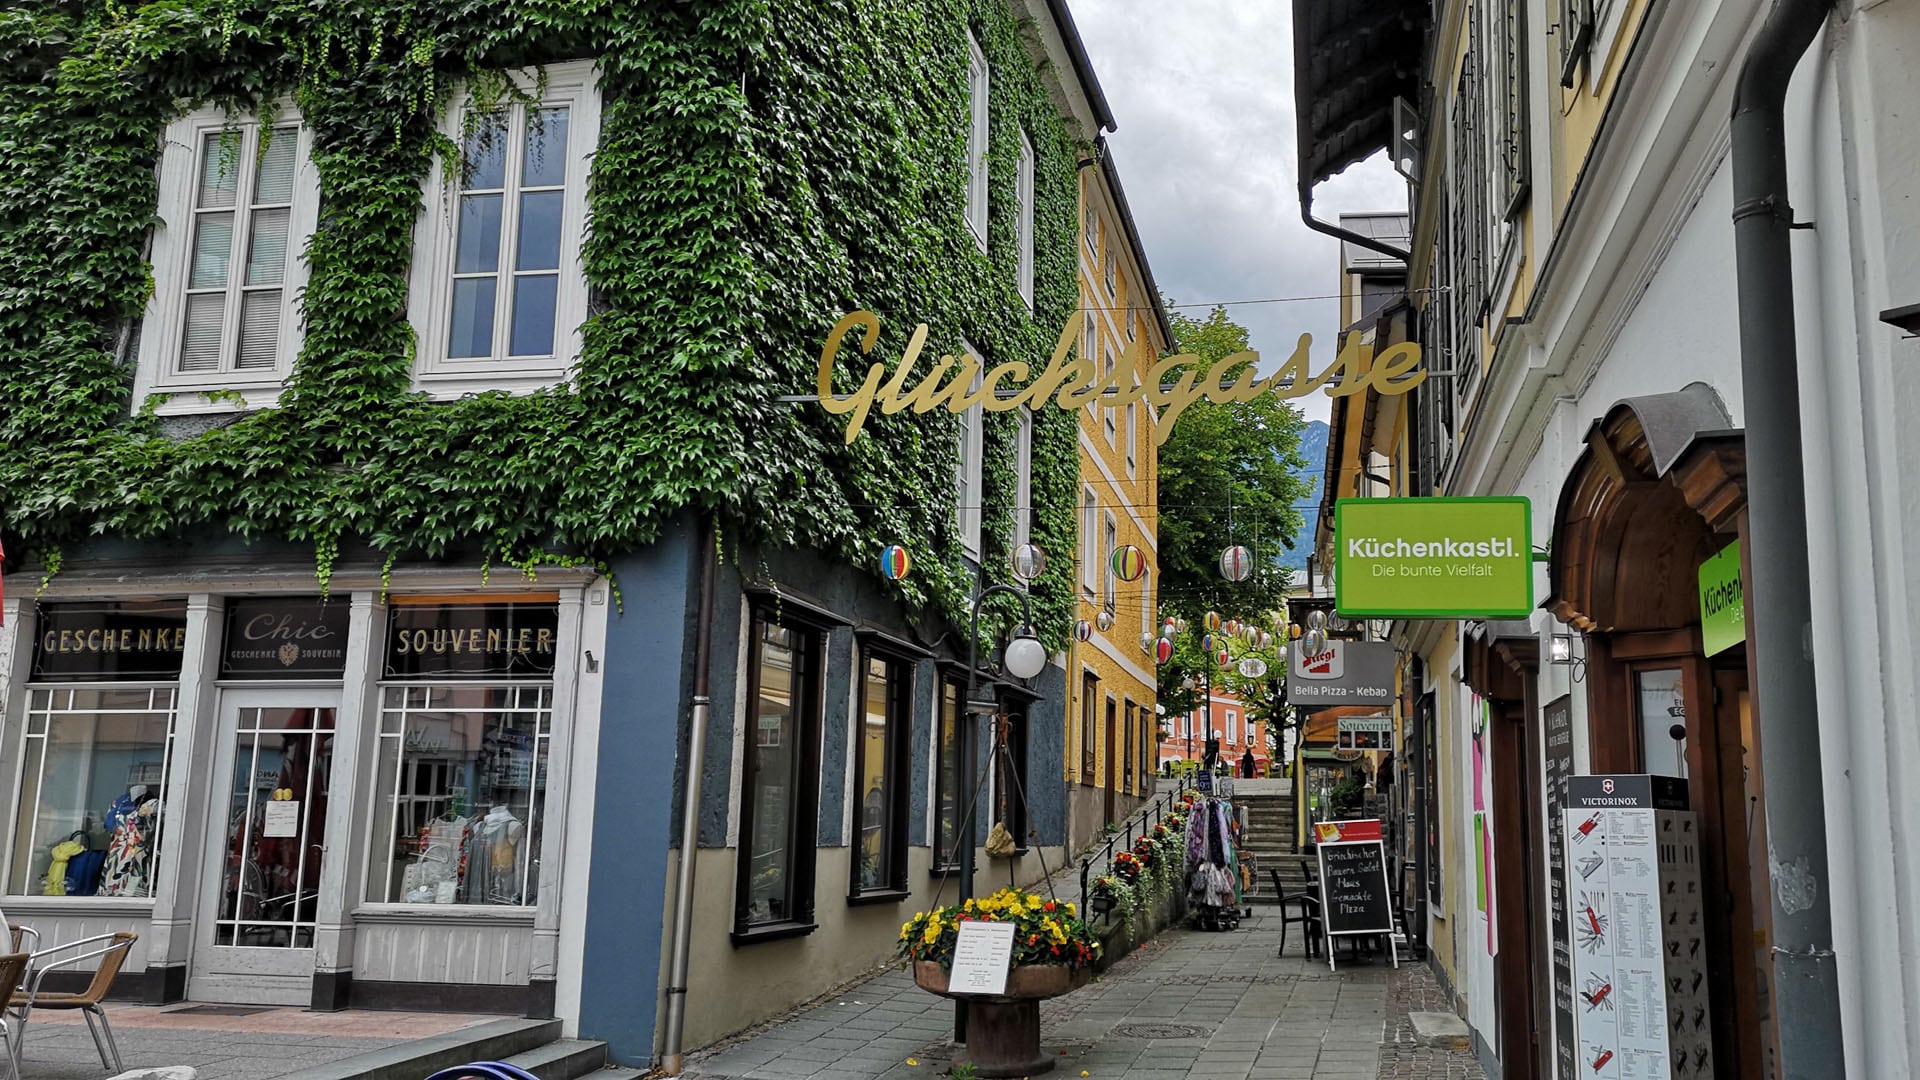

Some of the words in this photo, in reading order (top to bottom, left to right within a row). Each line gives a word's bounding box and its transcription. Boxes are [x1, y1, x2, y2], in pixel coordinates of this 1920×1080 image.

[818, 310, 1427, 446] Glücksgasse
[1349, 537, 1520, 558] Küchenkastl.
[1372, 564, 1396, 577] Die
[1400, 564, 1442, 577] bunte
[1446, 563, 1493, 577] Vielfalt
[244, 613, 335, 640] Chic
[44, 627, 187, 654] GESCHENKE
[397, 627, 553, 655] SOUVENIER
[231, 649, 276, 659] GESCHENKE
[302, 648, 341, 658] SOUVENIR
[1295, 685, 1319, 696] Bella
[1321, 686, 1347, 697] Pizza
[1356, 686, 1388, 698] Kebap
[1339, 720, 1391, 731] Souvenir
[1581, 797, 1638, 806] VICTORINOX
[1340, 903, 1366, 915] Pizza
